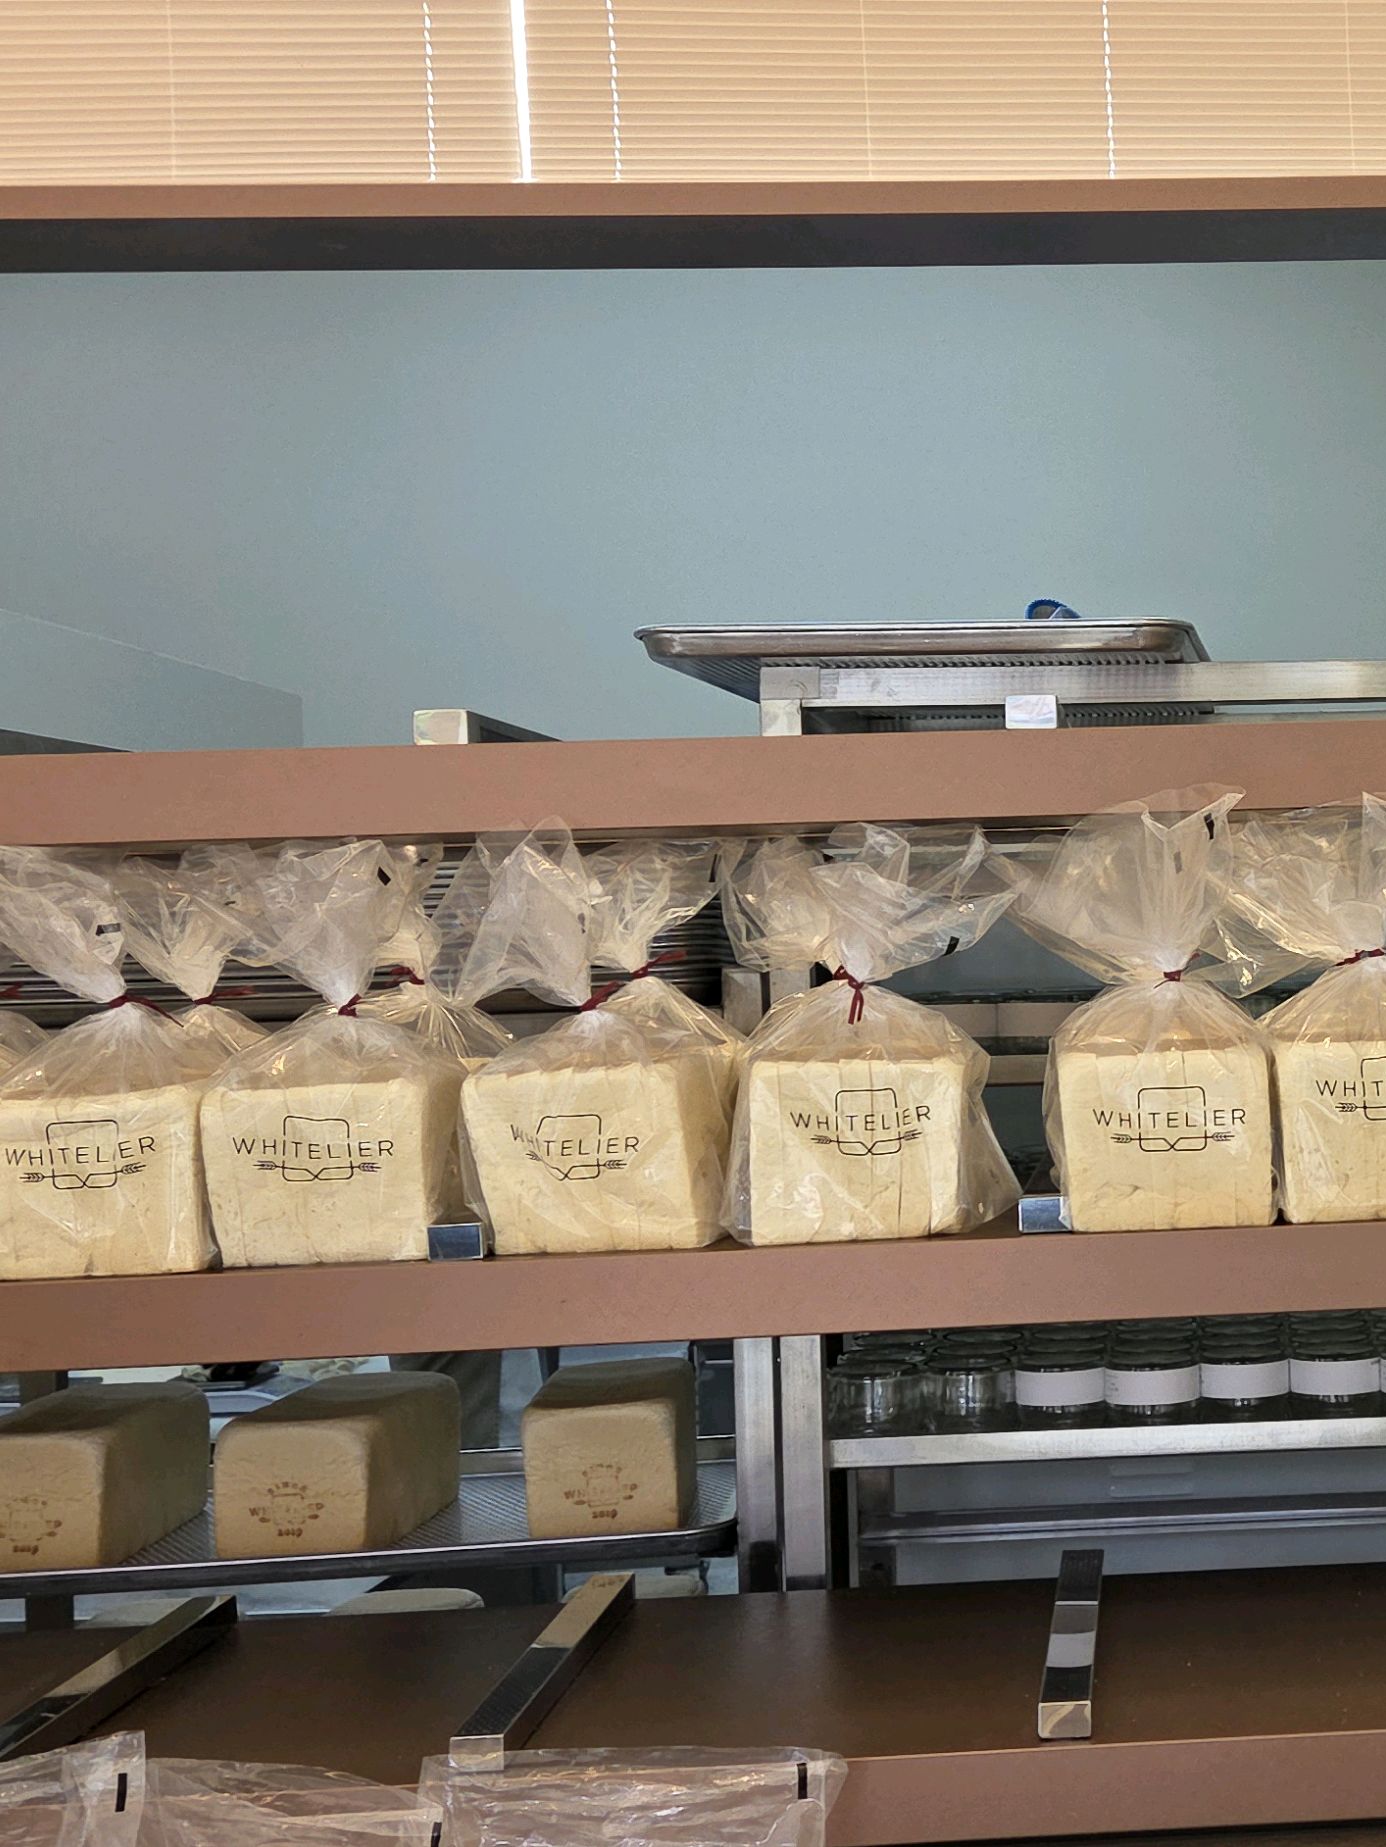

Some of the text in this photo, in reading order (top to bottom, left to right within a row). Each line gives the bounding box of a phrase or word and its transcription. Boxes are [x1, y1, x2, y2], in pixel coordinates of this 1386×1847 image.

[789, 1105, 931, 1131] WHITELIER
[1092, 1108, 1246, 1129] WHITELIER
[5, 1136, 156, 1167] WHITELIER
[232, 1136, 395, 1160] WHITELIER
